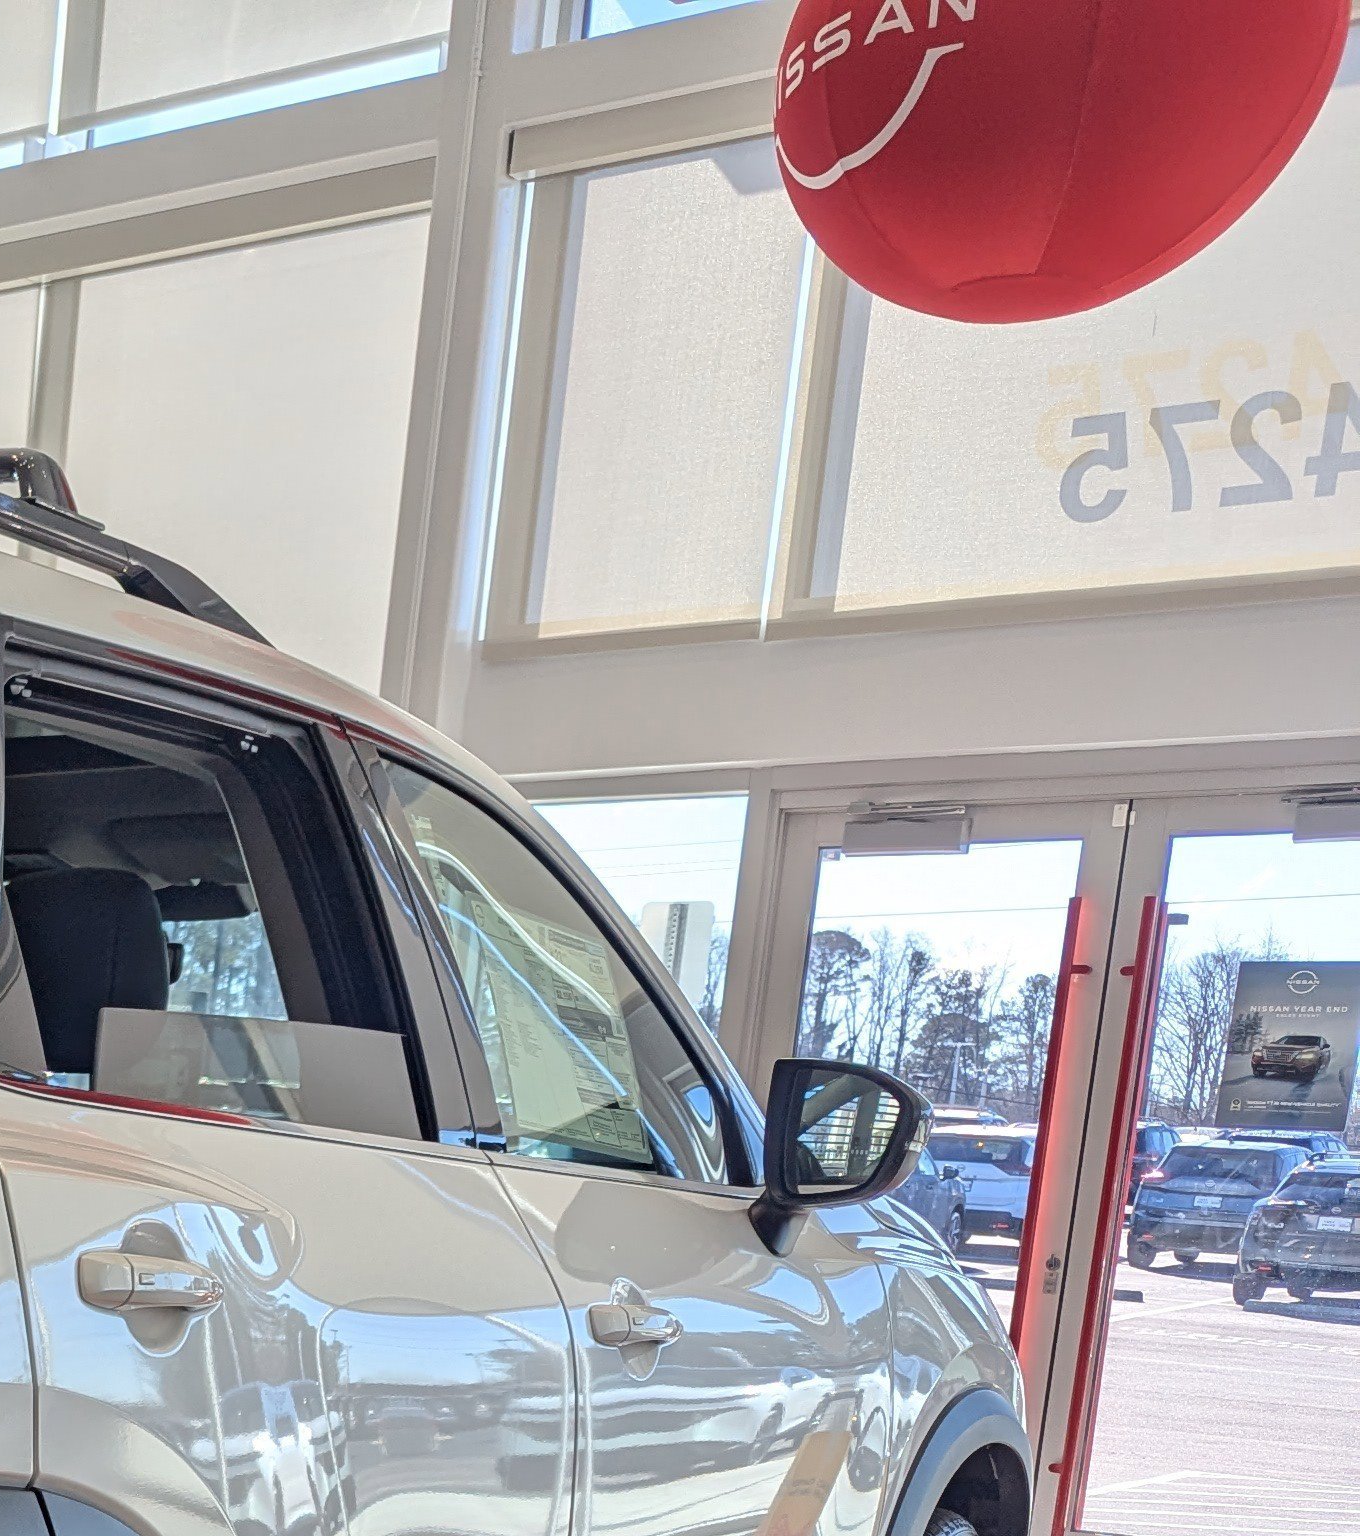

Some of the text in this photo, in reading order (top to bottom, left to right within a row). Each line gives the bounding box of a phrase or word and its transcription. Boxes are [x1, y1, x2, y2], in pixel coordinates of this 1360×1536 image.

[774, 0, 976, 118] ISSAN
[1249, 1005, 1290, 1013] NISSAN
[1294, 1005, 1322, 1013] YEAR
